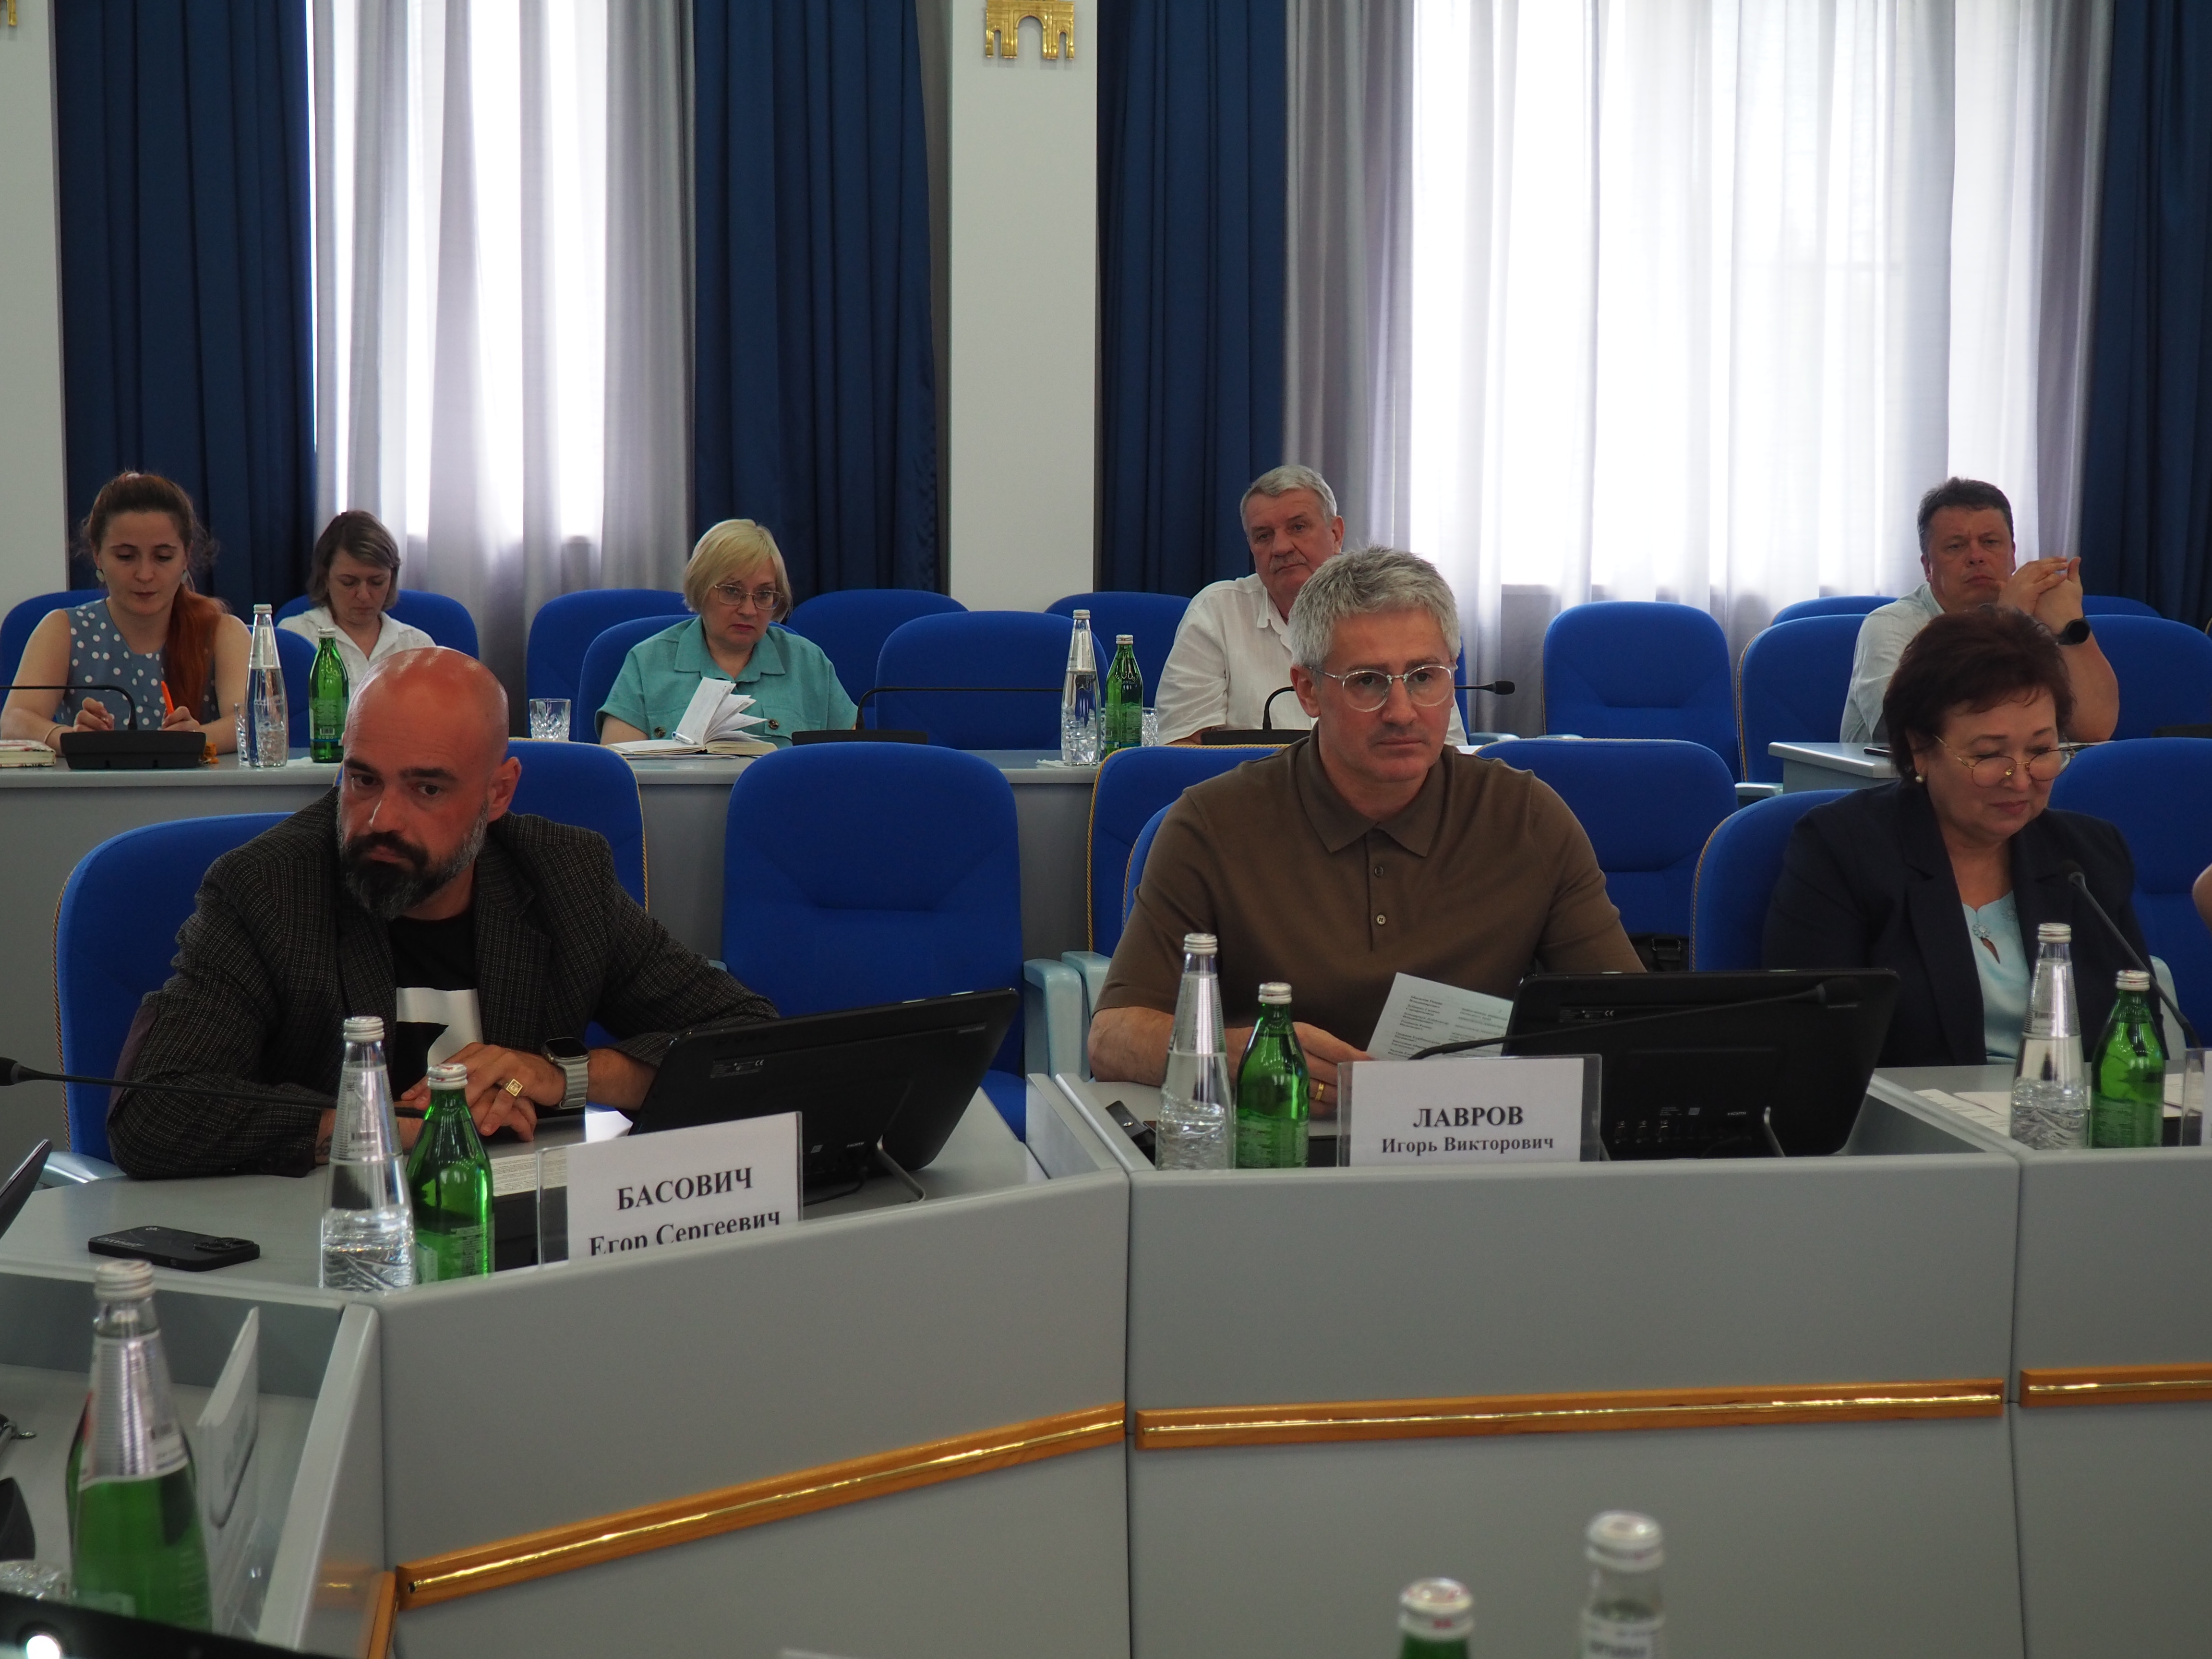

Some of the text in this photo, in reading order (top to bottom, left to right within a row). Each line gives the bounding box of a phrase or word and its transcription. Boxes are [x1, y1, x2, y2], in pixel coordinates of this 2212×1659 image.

[1413, 1106, 1524, 1128] ЛАВРОВ
[1382, 1137, 1553, 1156] Игорь Викторович
[617, 1167, 752, 1210] БАСОВИЧ
